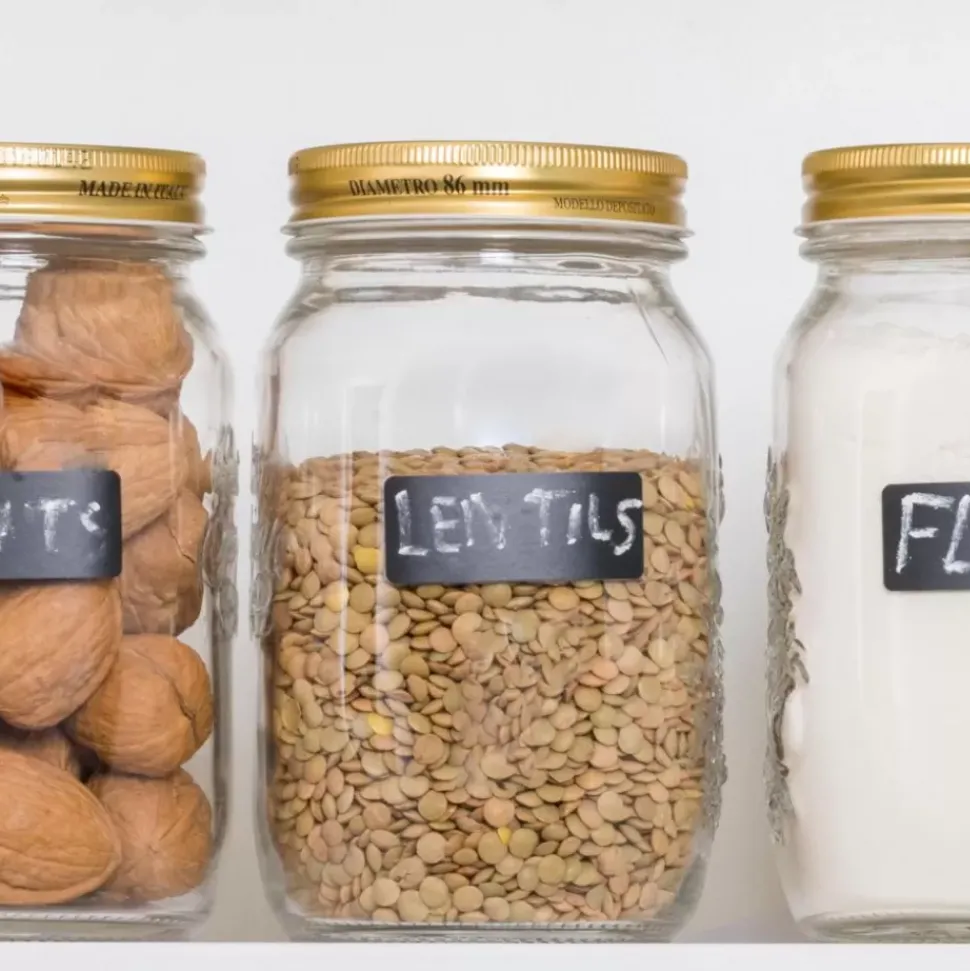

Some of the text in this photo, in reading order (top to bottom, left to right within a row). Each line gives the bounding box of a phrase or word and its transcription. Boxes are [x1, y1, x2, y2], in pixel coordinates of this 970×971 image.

[78, 180, 132, 198] MADE
[134, 182, 153, 199] IN
[349, 174, 511, 197] DIAMETRO 86 mm
[552, 197, 604, 212] MODELLO
